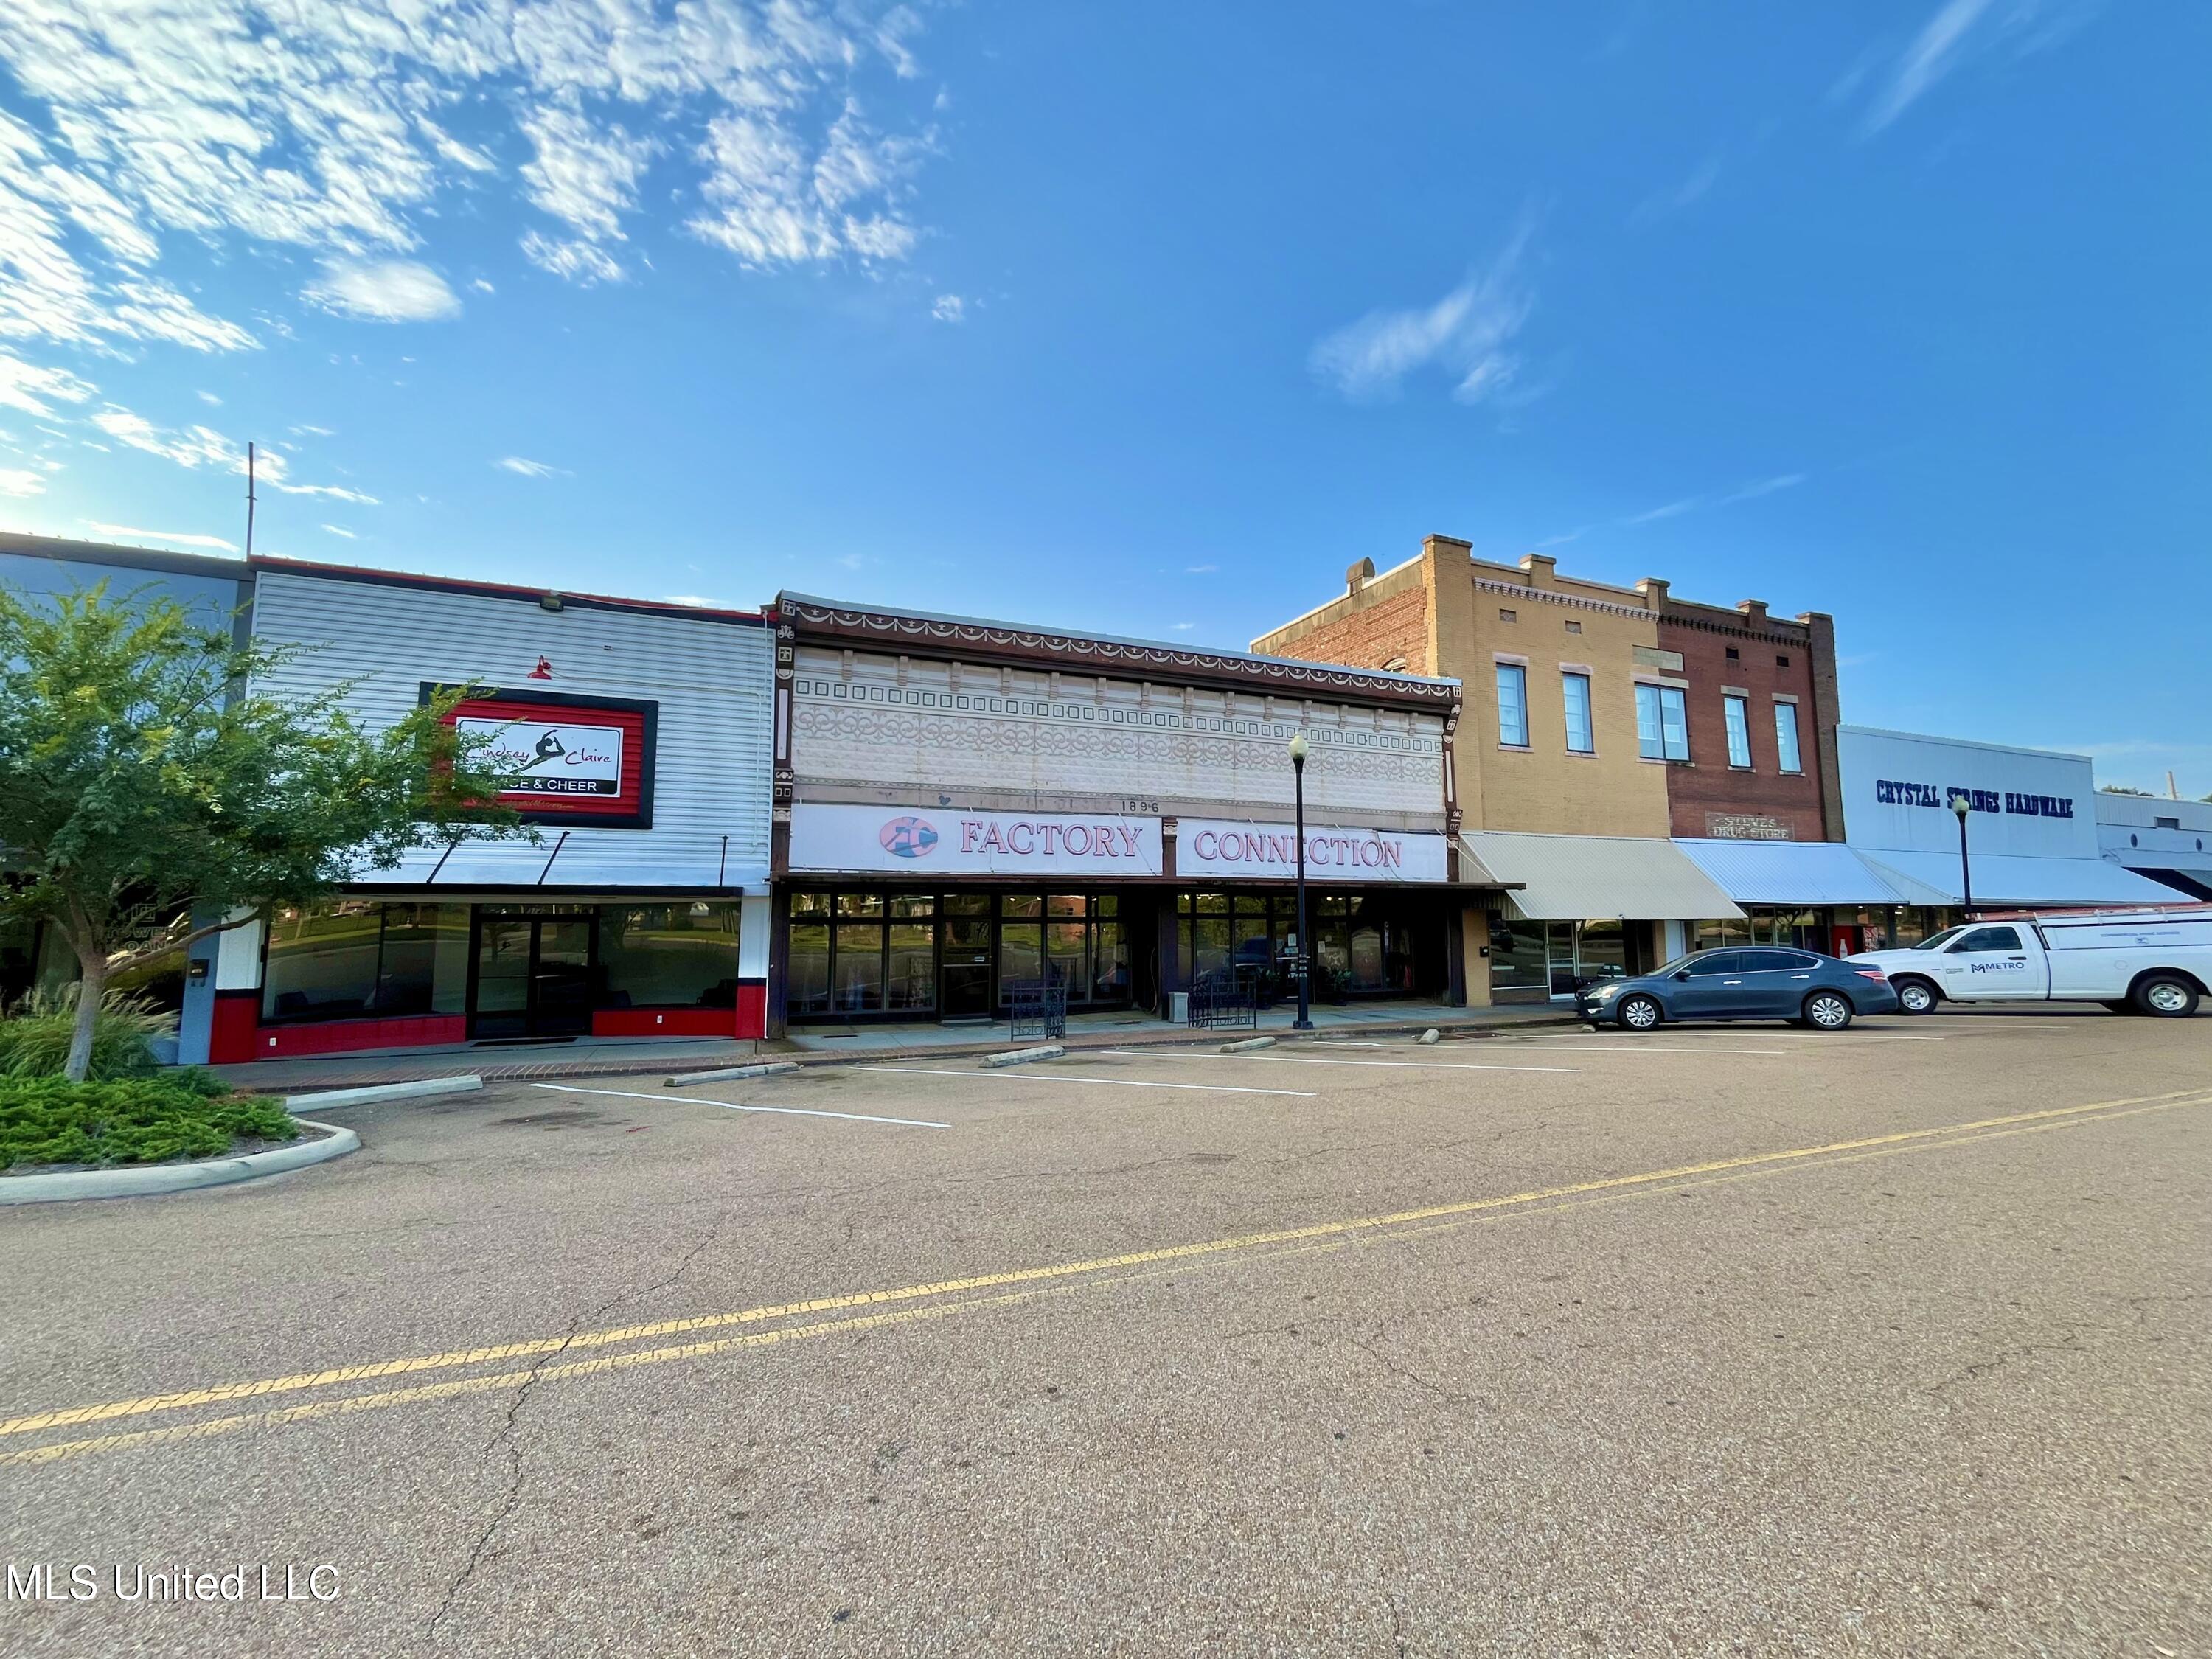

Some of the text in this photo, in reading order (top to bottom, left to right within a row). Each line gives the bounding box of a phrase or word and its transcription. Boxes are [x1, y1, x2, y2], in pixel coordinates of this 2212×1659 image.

[565, 748, 612, 765] Claire
[533, 779, 543, 790] &
[547, 779, 597, 792] CHEER
[1876, 779, 1941, 808] CRYSTAL
[2004, 792, 2073, 818] HARDWARE
[1121, 801, 1159, 813] 1896
[960, 820, 1143, 858] FACTORY
[1713, 826, 1789, 839] DRUG STORE
[1194, 830, 1402, 868] CONNECTION
[1986, 961, 2025, 970] METRO
